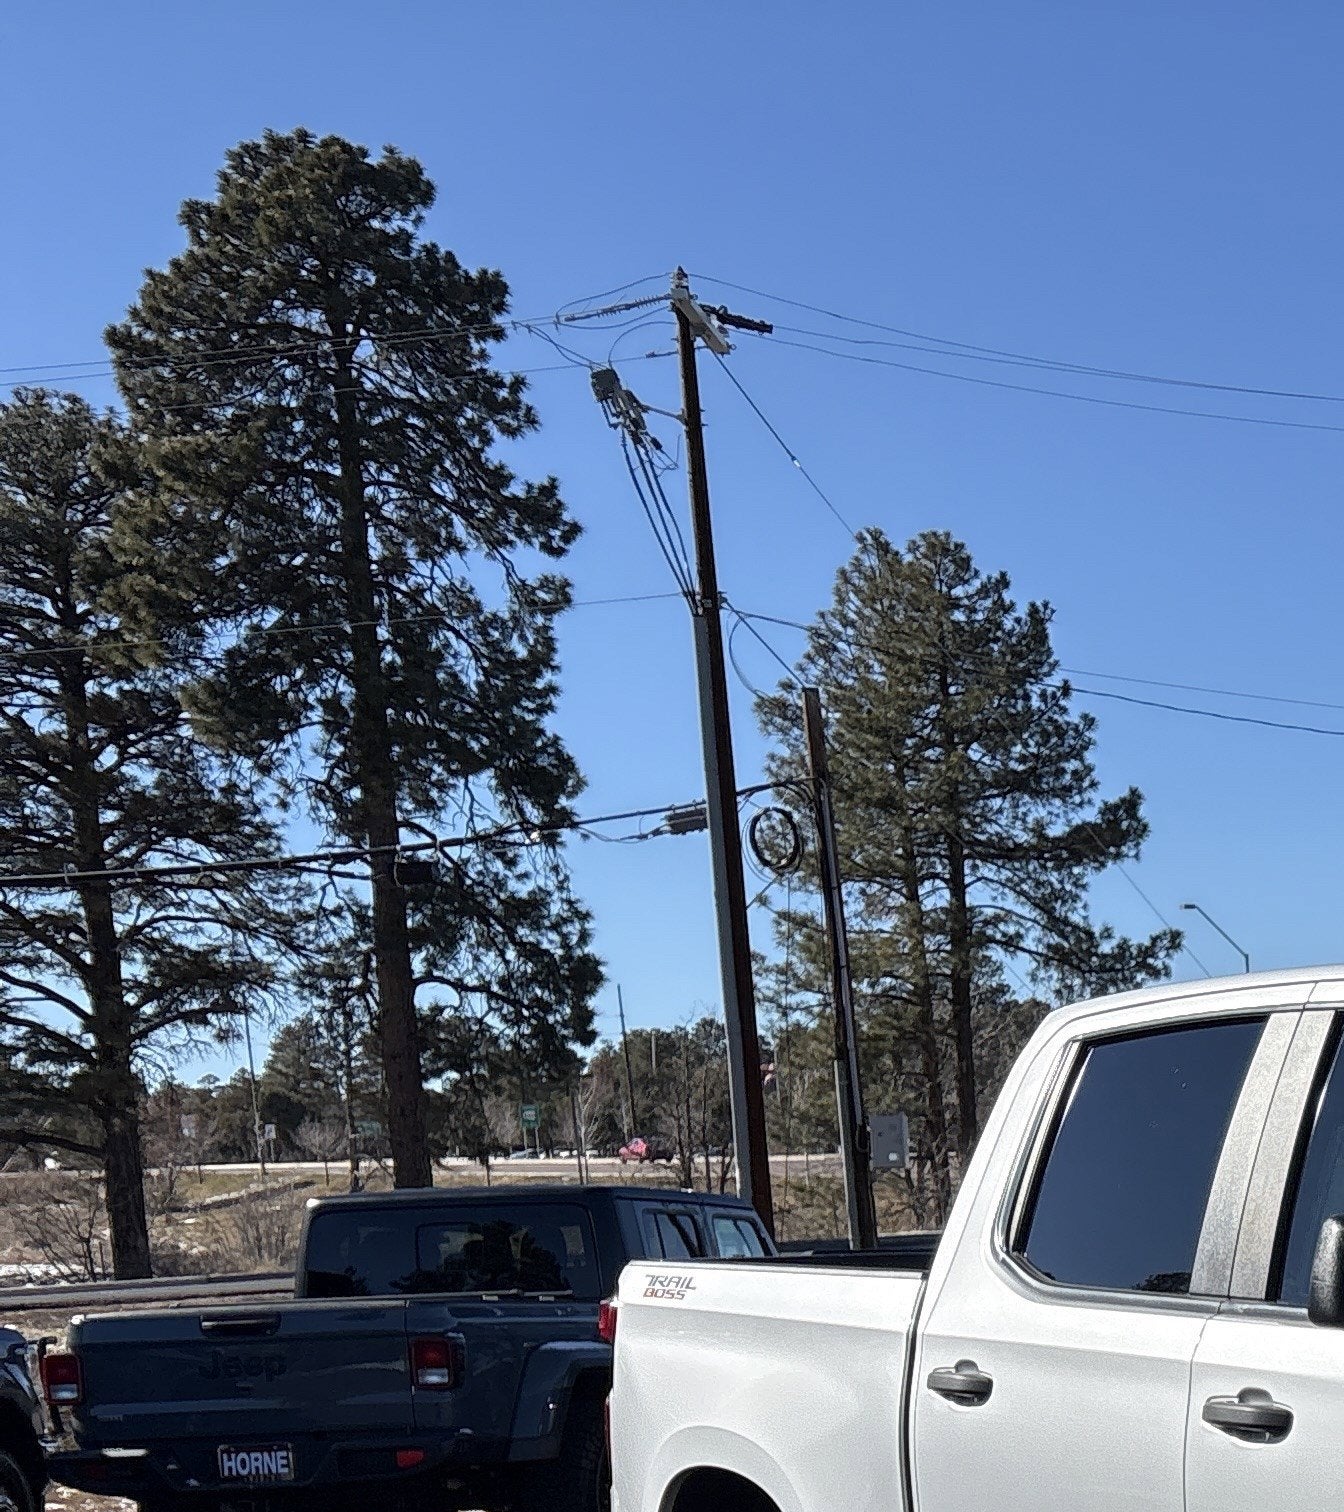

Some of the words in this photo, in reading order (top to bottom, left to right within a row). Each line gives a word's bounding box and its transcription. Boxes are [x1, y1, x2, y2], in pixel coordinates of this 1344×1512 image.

[645, 1274, 697, 1290] TRAIL
[643, 1287, 687, 1300] BOSS
[222, 1450, 289, 1476] HORNE
